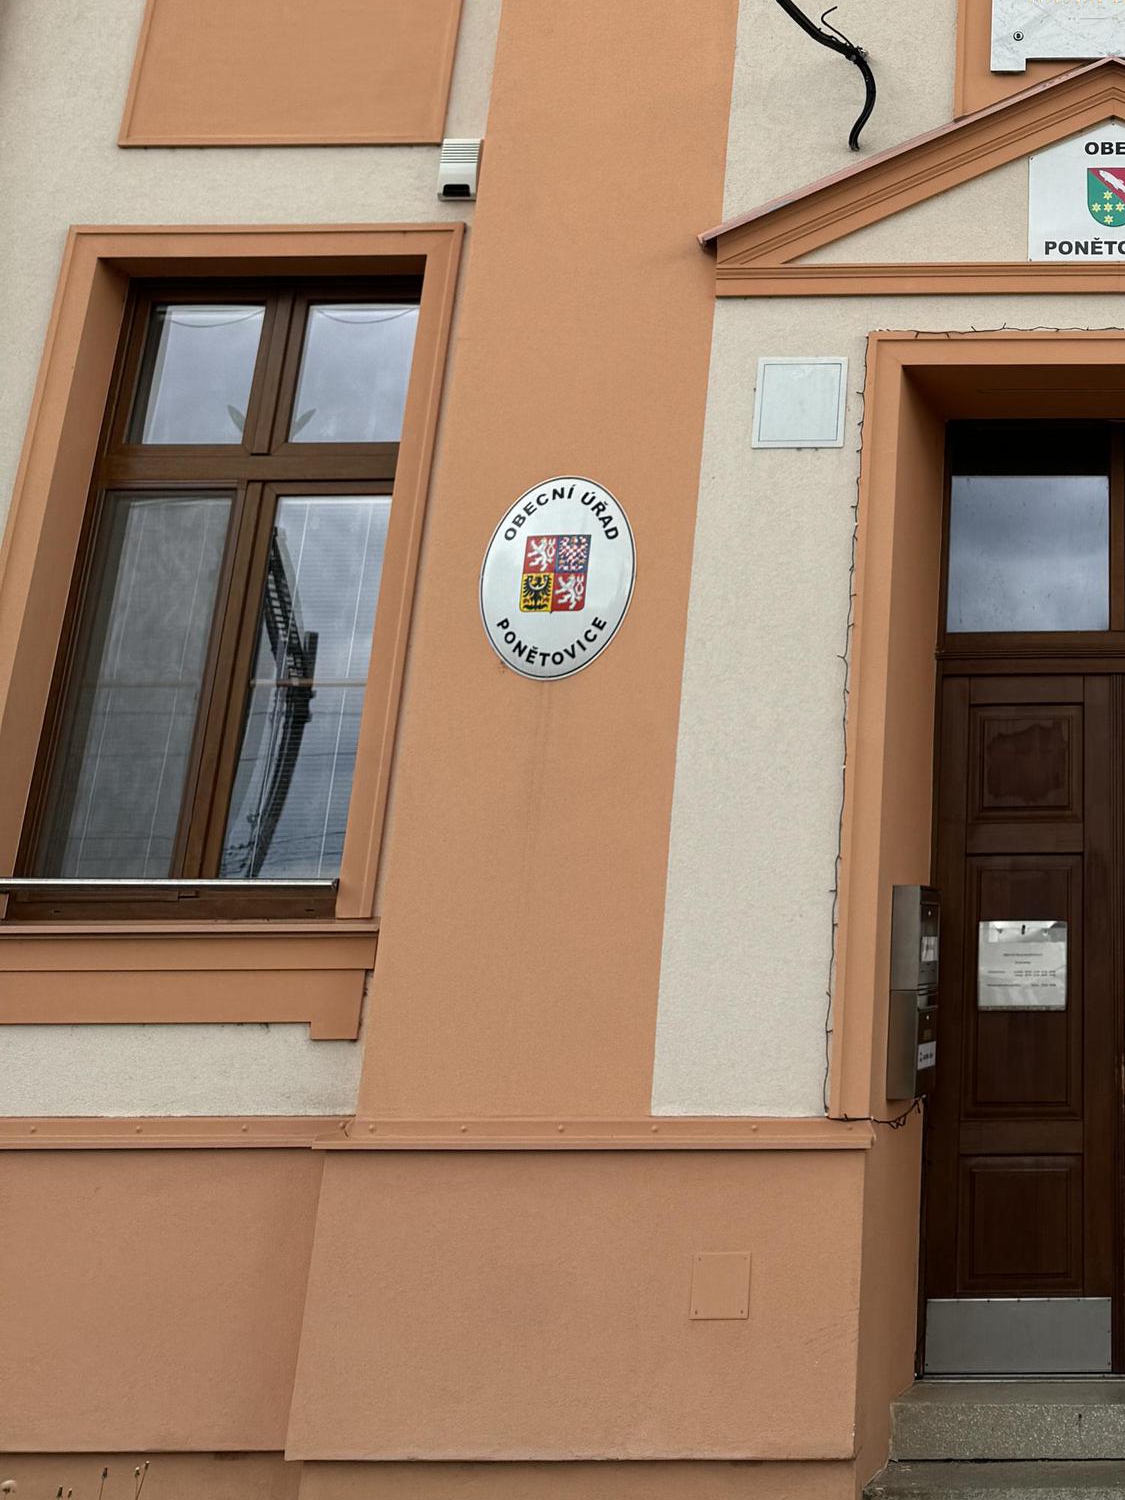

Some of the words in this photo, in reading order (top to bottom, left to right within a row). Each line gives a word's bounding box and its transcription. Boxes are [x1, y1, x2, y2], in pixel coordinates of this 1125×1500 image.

[504, 484, 577, 541] OBECNÍ
[580, 491, 619, 540] ÚŘAD
[496, 616, 607, 667] PONĚTOVICE
